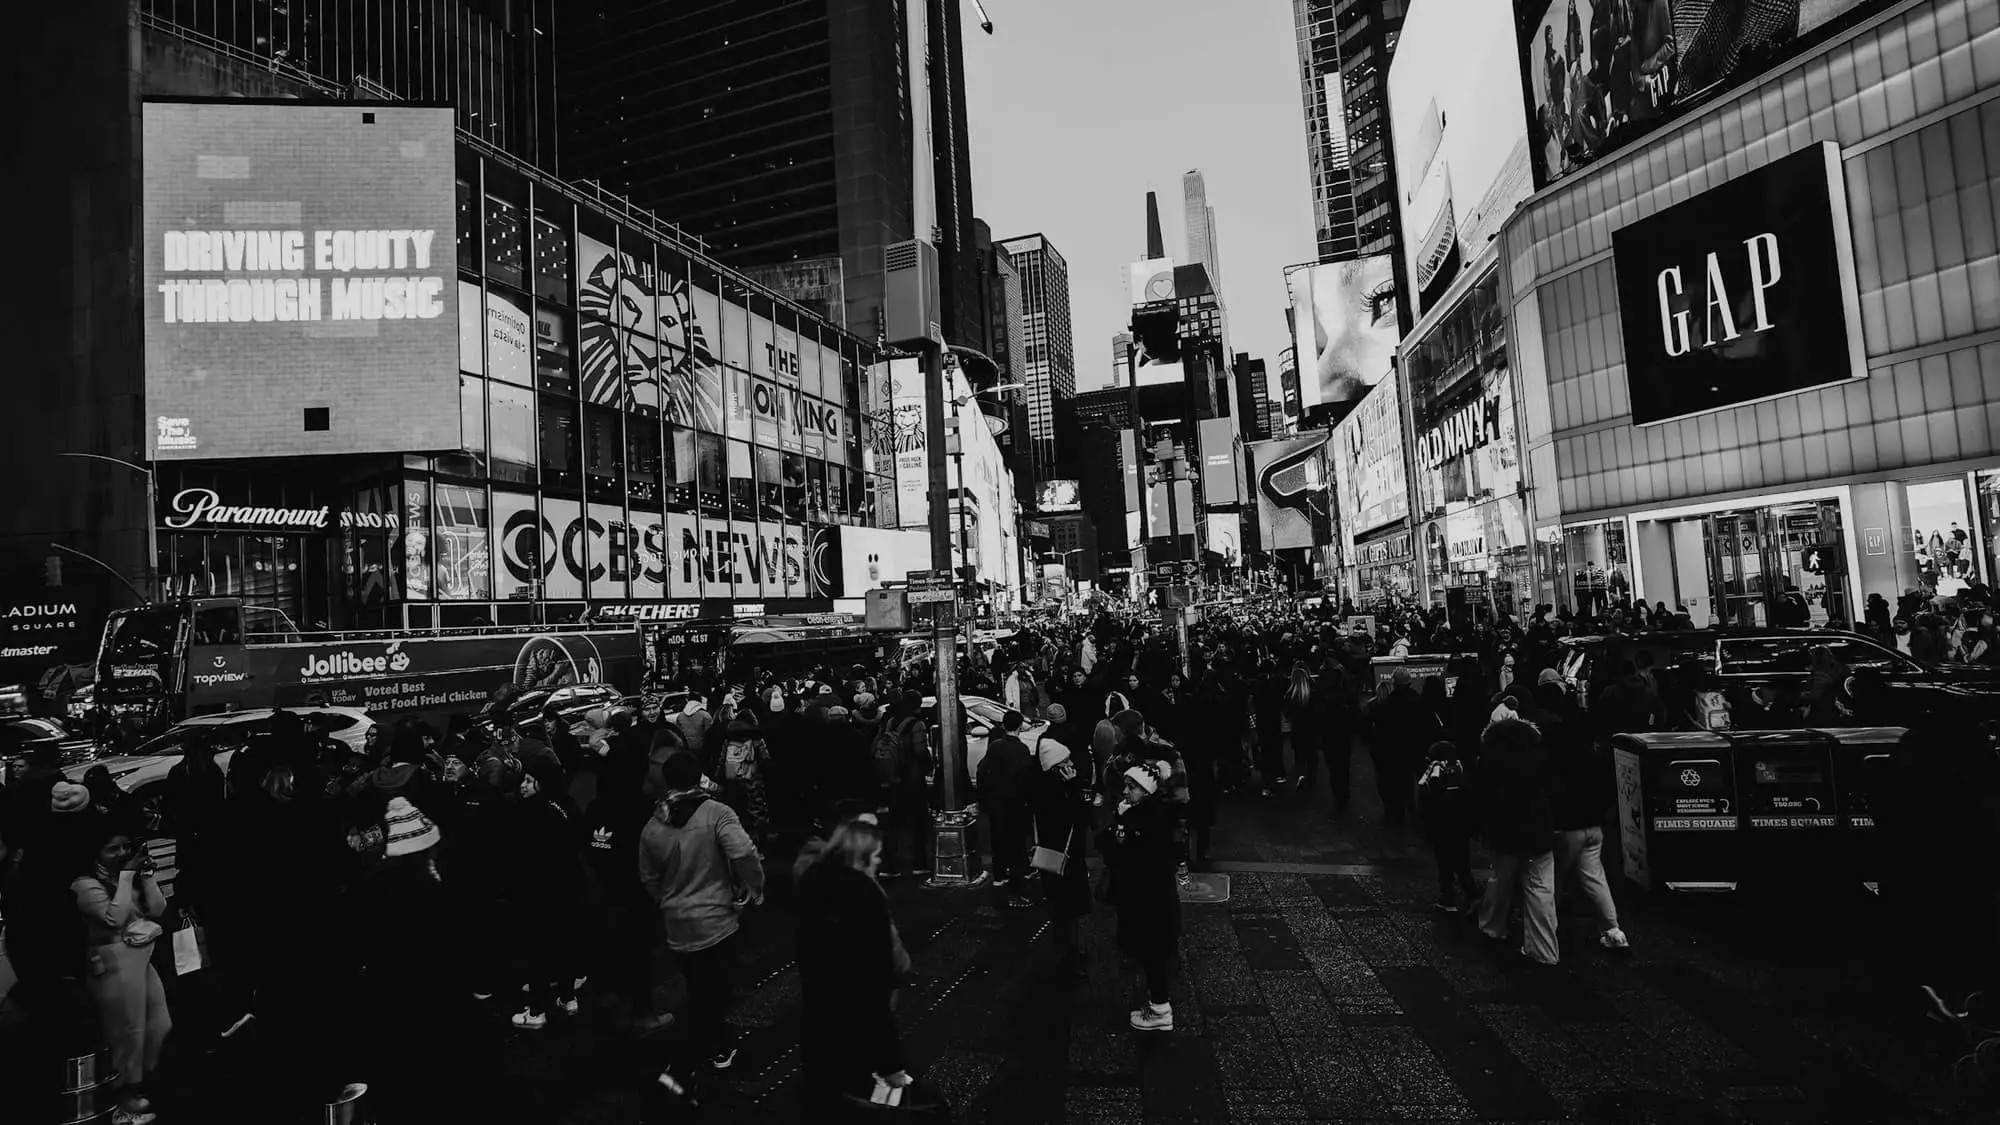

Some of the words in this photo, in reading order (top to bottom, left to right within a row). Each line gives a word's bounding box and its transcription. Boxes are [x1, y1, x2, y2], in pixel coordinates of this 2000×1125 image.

[163, 230, 305, 271] DRIVING
[314, 229, 435, 271] EQUITY
[158, 278, 321, 323] THROUGH
[331, 277, 444, 321] MUSIC
[1656, 231, 1784, 358] GAP
[765, 342, 799, 377] THE
[1417, 426, 1443, 473] OLD
[1443, 396, 1485, 460] NAVY
[164, 487, 330, 528] Paramount
[563, 516, 671, 584] CBS
[683, 528, 801, 587] NEWS
[11, 621, 76, 631] SQUARE
[599, 603, 701, 621] SKECHERS
[301, 650, 388, 677] Jollibee
[364, 683, 400, 697] Voted
[401, 681, 425, 694] Best
[364, 699, 389, 713] Fast
[390, 697, 419, 710] Food
[420, 693, 447, 707] Fried
[448, 689, 488, 703] Chicken
[1656, 819, 1690, 829] TIMES
[1693, 818, 1736, 830] SQUARE
[1752, 818, 1788, 828] TIMES
[1790, 817, 1835, 828] SQUARE
